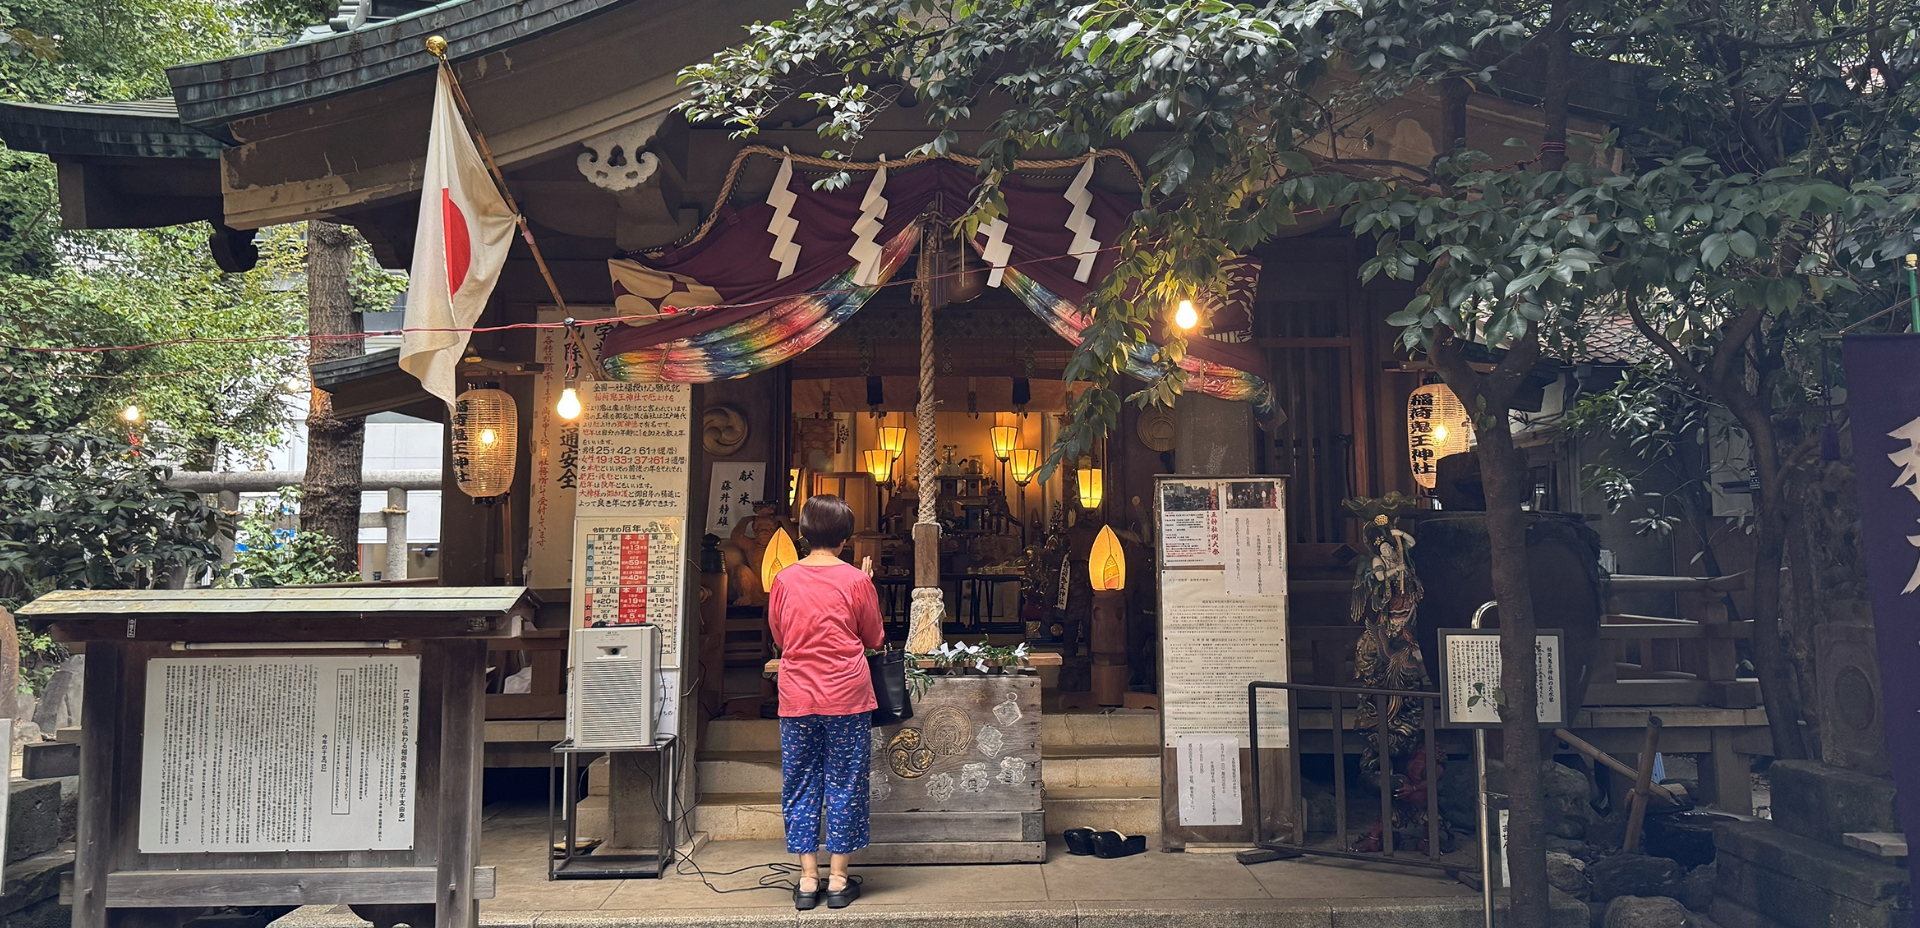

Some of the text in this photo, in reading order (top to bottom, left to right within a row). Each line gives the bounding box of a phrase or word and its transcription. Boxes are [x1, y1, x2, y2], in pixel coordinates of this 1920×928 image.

[1411, 393, 1437, 474] 稲荷鬼王神社
[739, 470, 754, 505] 献米
